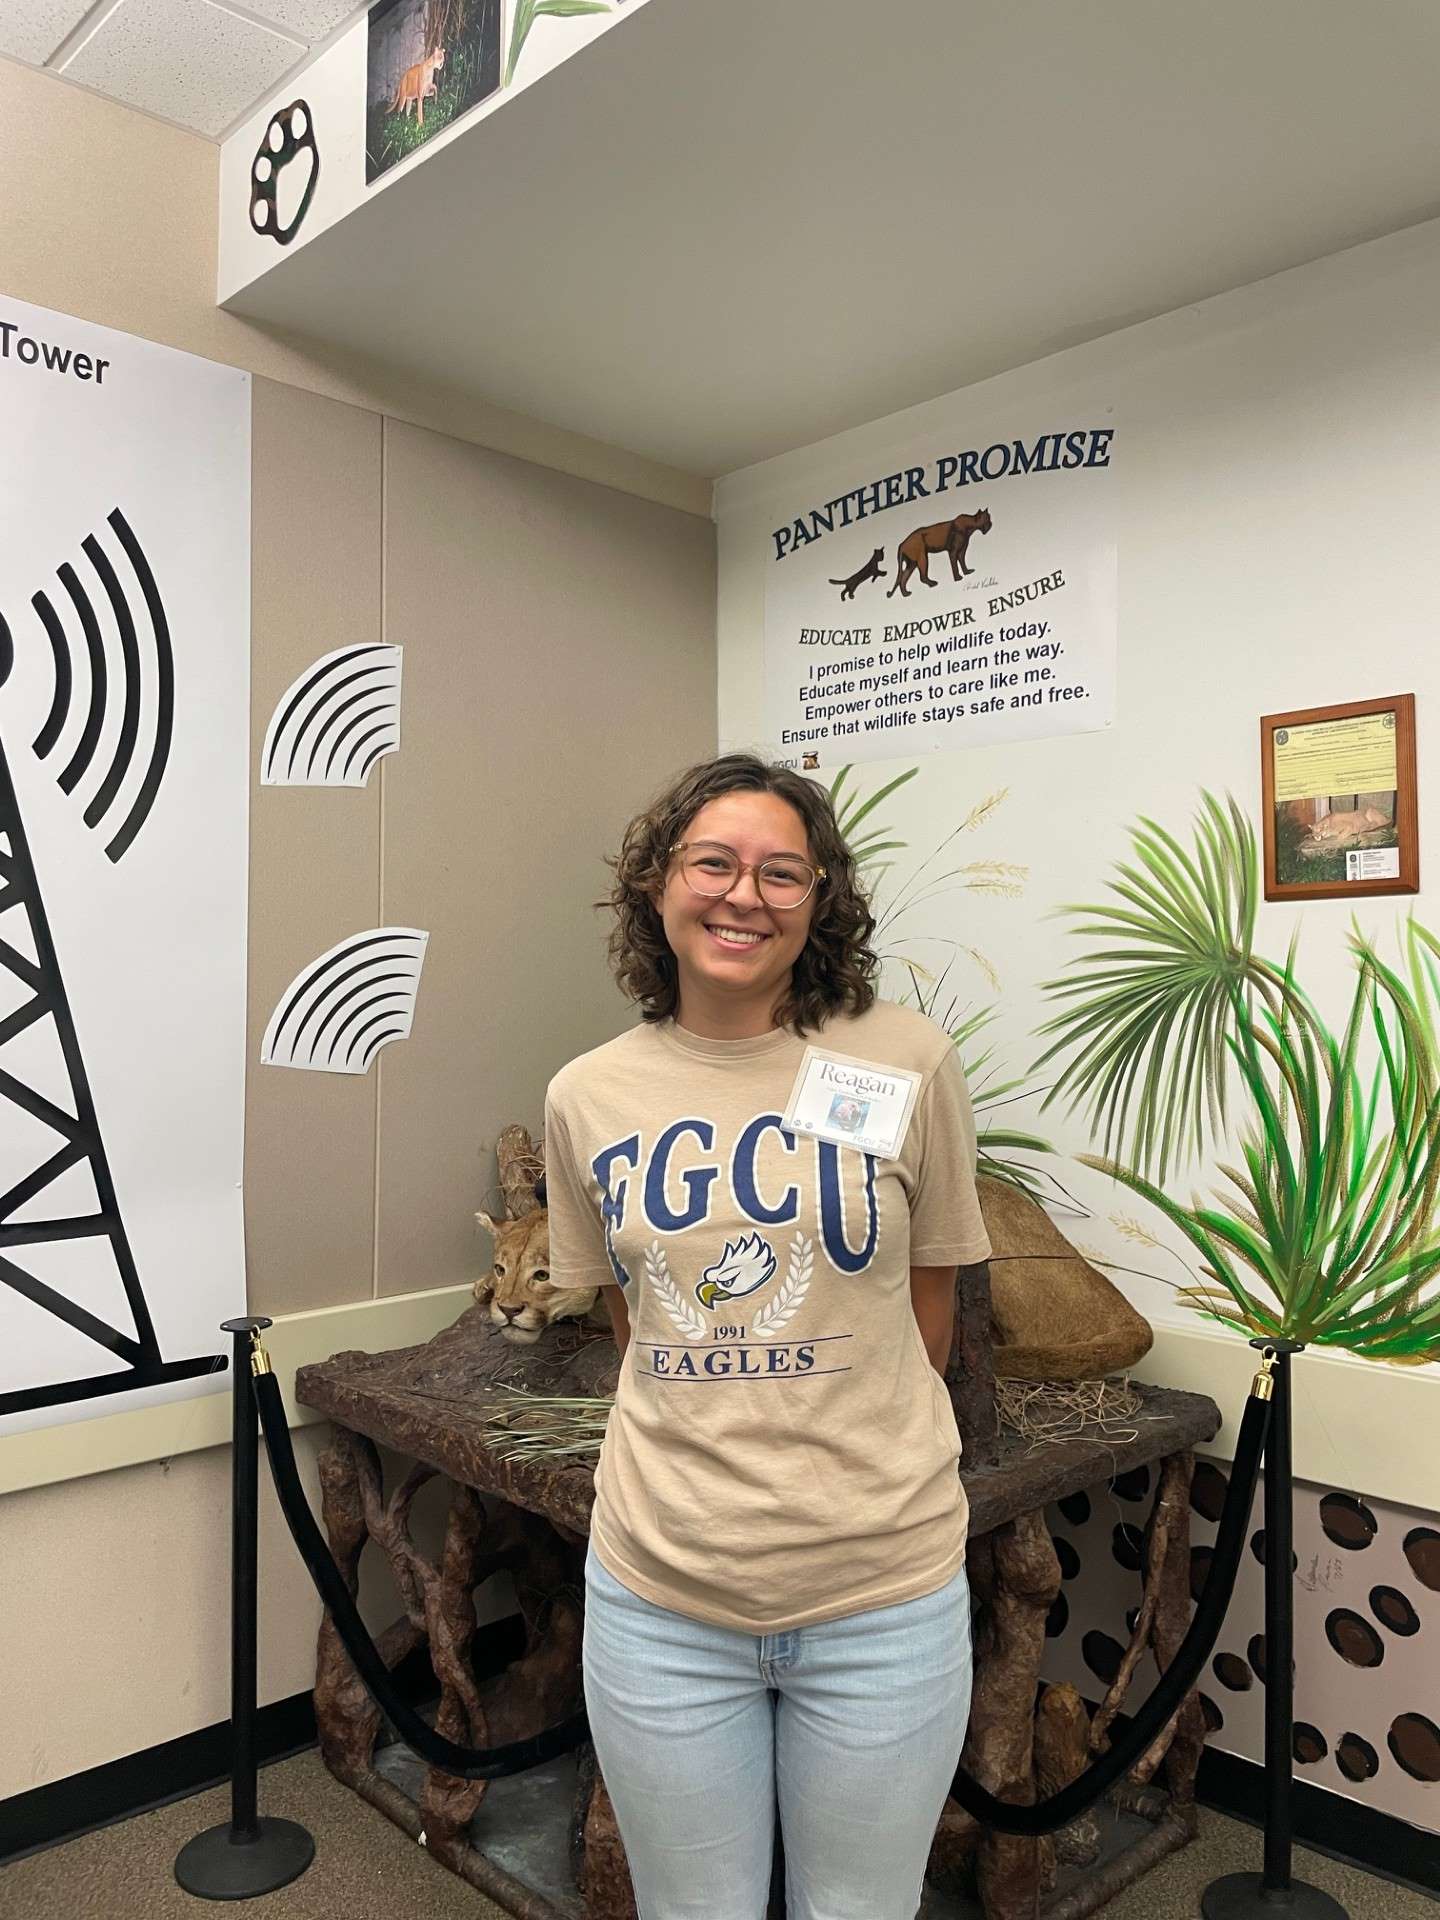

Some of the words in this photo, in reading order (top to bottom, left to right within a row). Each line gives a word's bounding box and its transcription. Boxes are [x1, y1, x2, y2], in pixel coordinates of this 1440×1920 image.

[0, 321, 110, 384] Tower
[772, 466, 930, 560] PANTHER
[936, 429, 1114, 492] PROMISE
[799, 628, 871, 646] EDUCATE
[883, 607, 976, 643] EMPOWER
[988, 570, 1066, 617] ENSURE
[799, 680, 855, 701] Educate
[860, 669, 909, 694] myself
[913, 662, 941, 681] and
[947, 656, 988, 674] learn
[994, 650, 1020, 666] the
[1026, 641, 1064, 661] way.
[809, 665, 813, 679] I
[817, 657, 875, 681] promise
[878, 652, 893, 665] to
[898, 644, 930, 666] help
[936, 630, 993, 654] wildlife
[1000, 620, 1052, 644] today.
[782, 726, 829, 744] Ensure
[833, 721, 860, 737] that
[864, 710, 917, 731] wildlife
[922, 704, 965, 724] stays
[970, 695, 1005, 714] safe
[1010, 690, 1042, 708] and
[1049, 684, 1090, 703] free.
[805, 698, 871, 722] Empower
[875, 691, 922, 710] others
[929, 686, 943, 699] to
[949, 678, 984, 696] care
[990, 671, 1018, 689] like
[1024, 666, 1056, 683] me.
[820, 1063, 896, 1096] Reagan
[592, 1112, 880, 1288] FGCU
[652, 1346, 814, 1375] EAGLES
[713, 1327, 746, 1340] 1991
